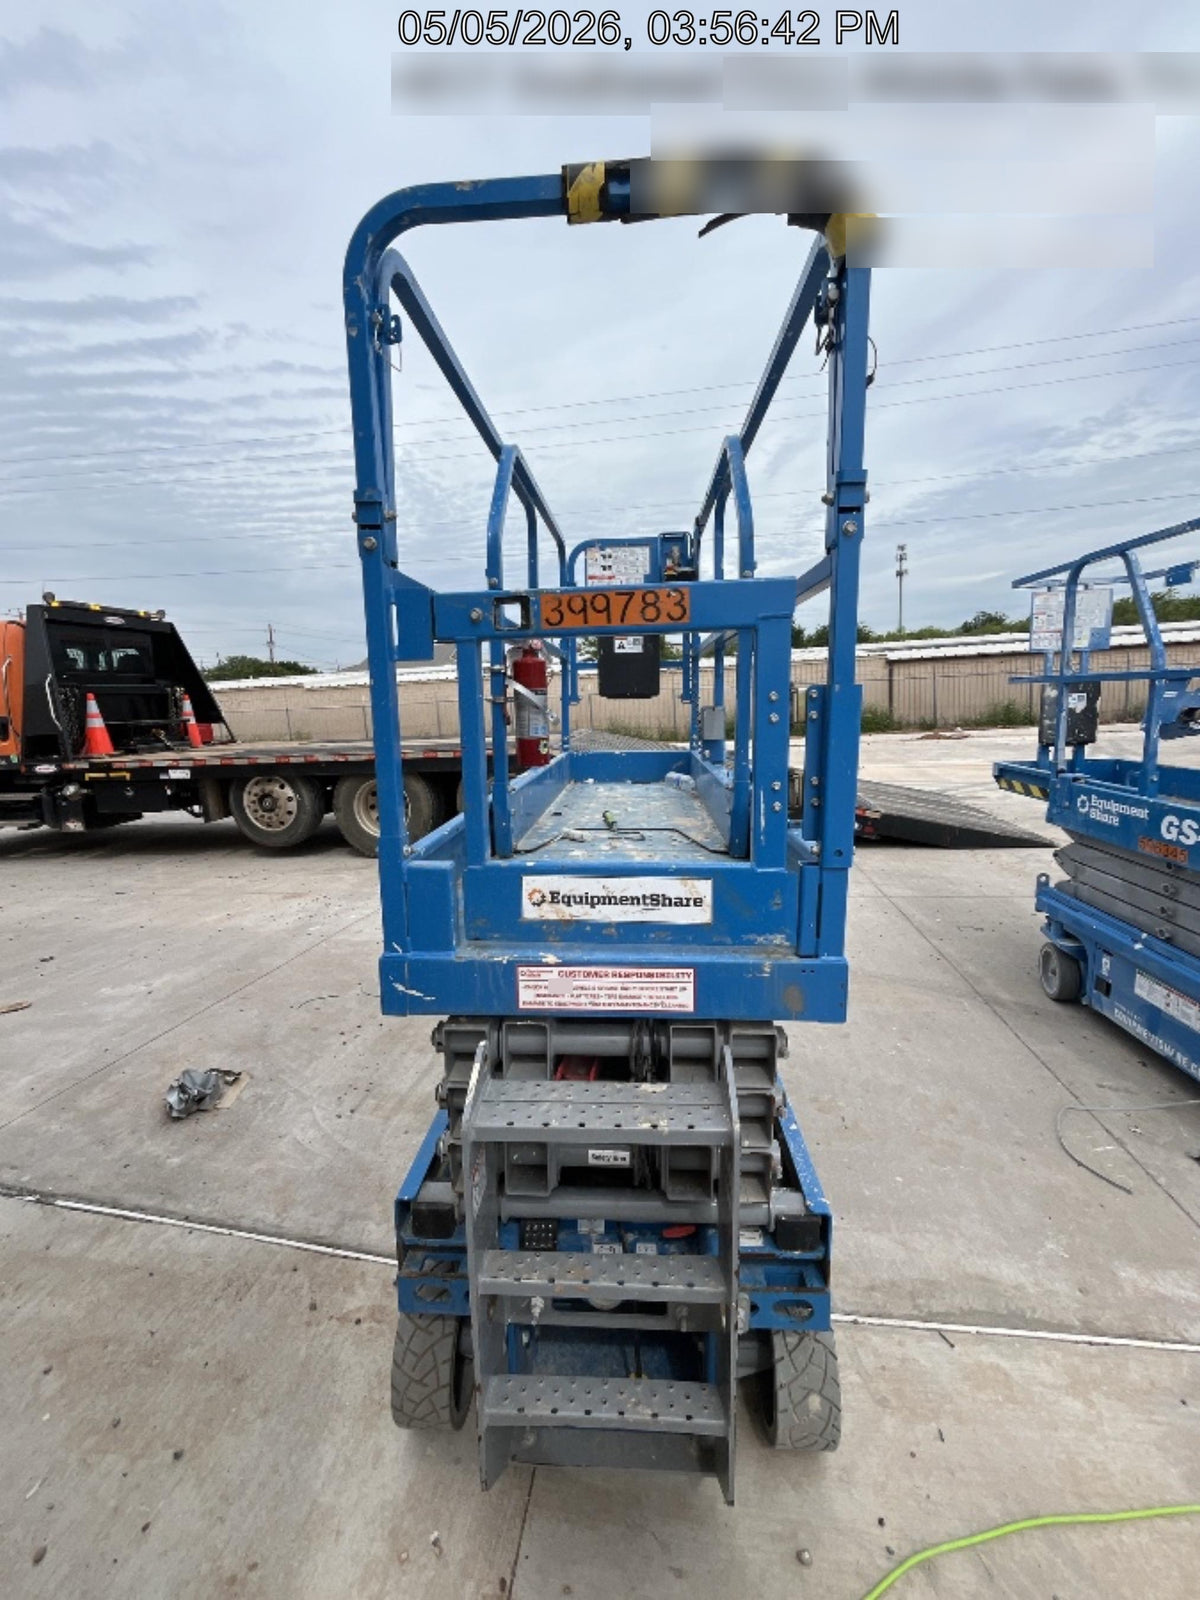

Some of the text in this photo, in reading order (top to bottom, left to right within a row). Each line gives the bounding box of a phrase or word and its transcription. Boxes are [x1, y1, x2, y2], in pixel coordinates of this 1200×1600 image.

[545, 588, 687, 626] 399783
[1089, 808, 1119, 826] Share
[1090, 794, 1149, 819] Equipment
[1161, 815, 1200, 845] GS
[549, 891, 704, 909] EquipmentShare
